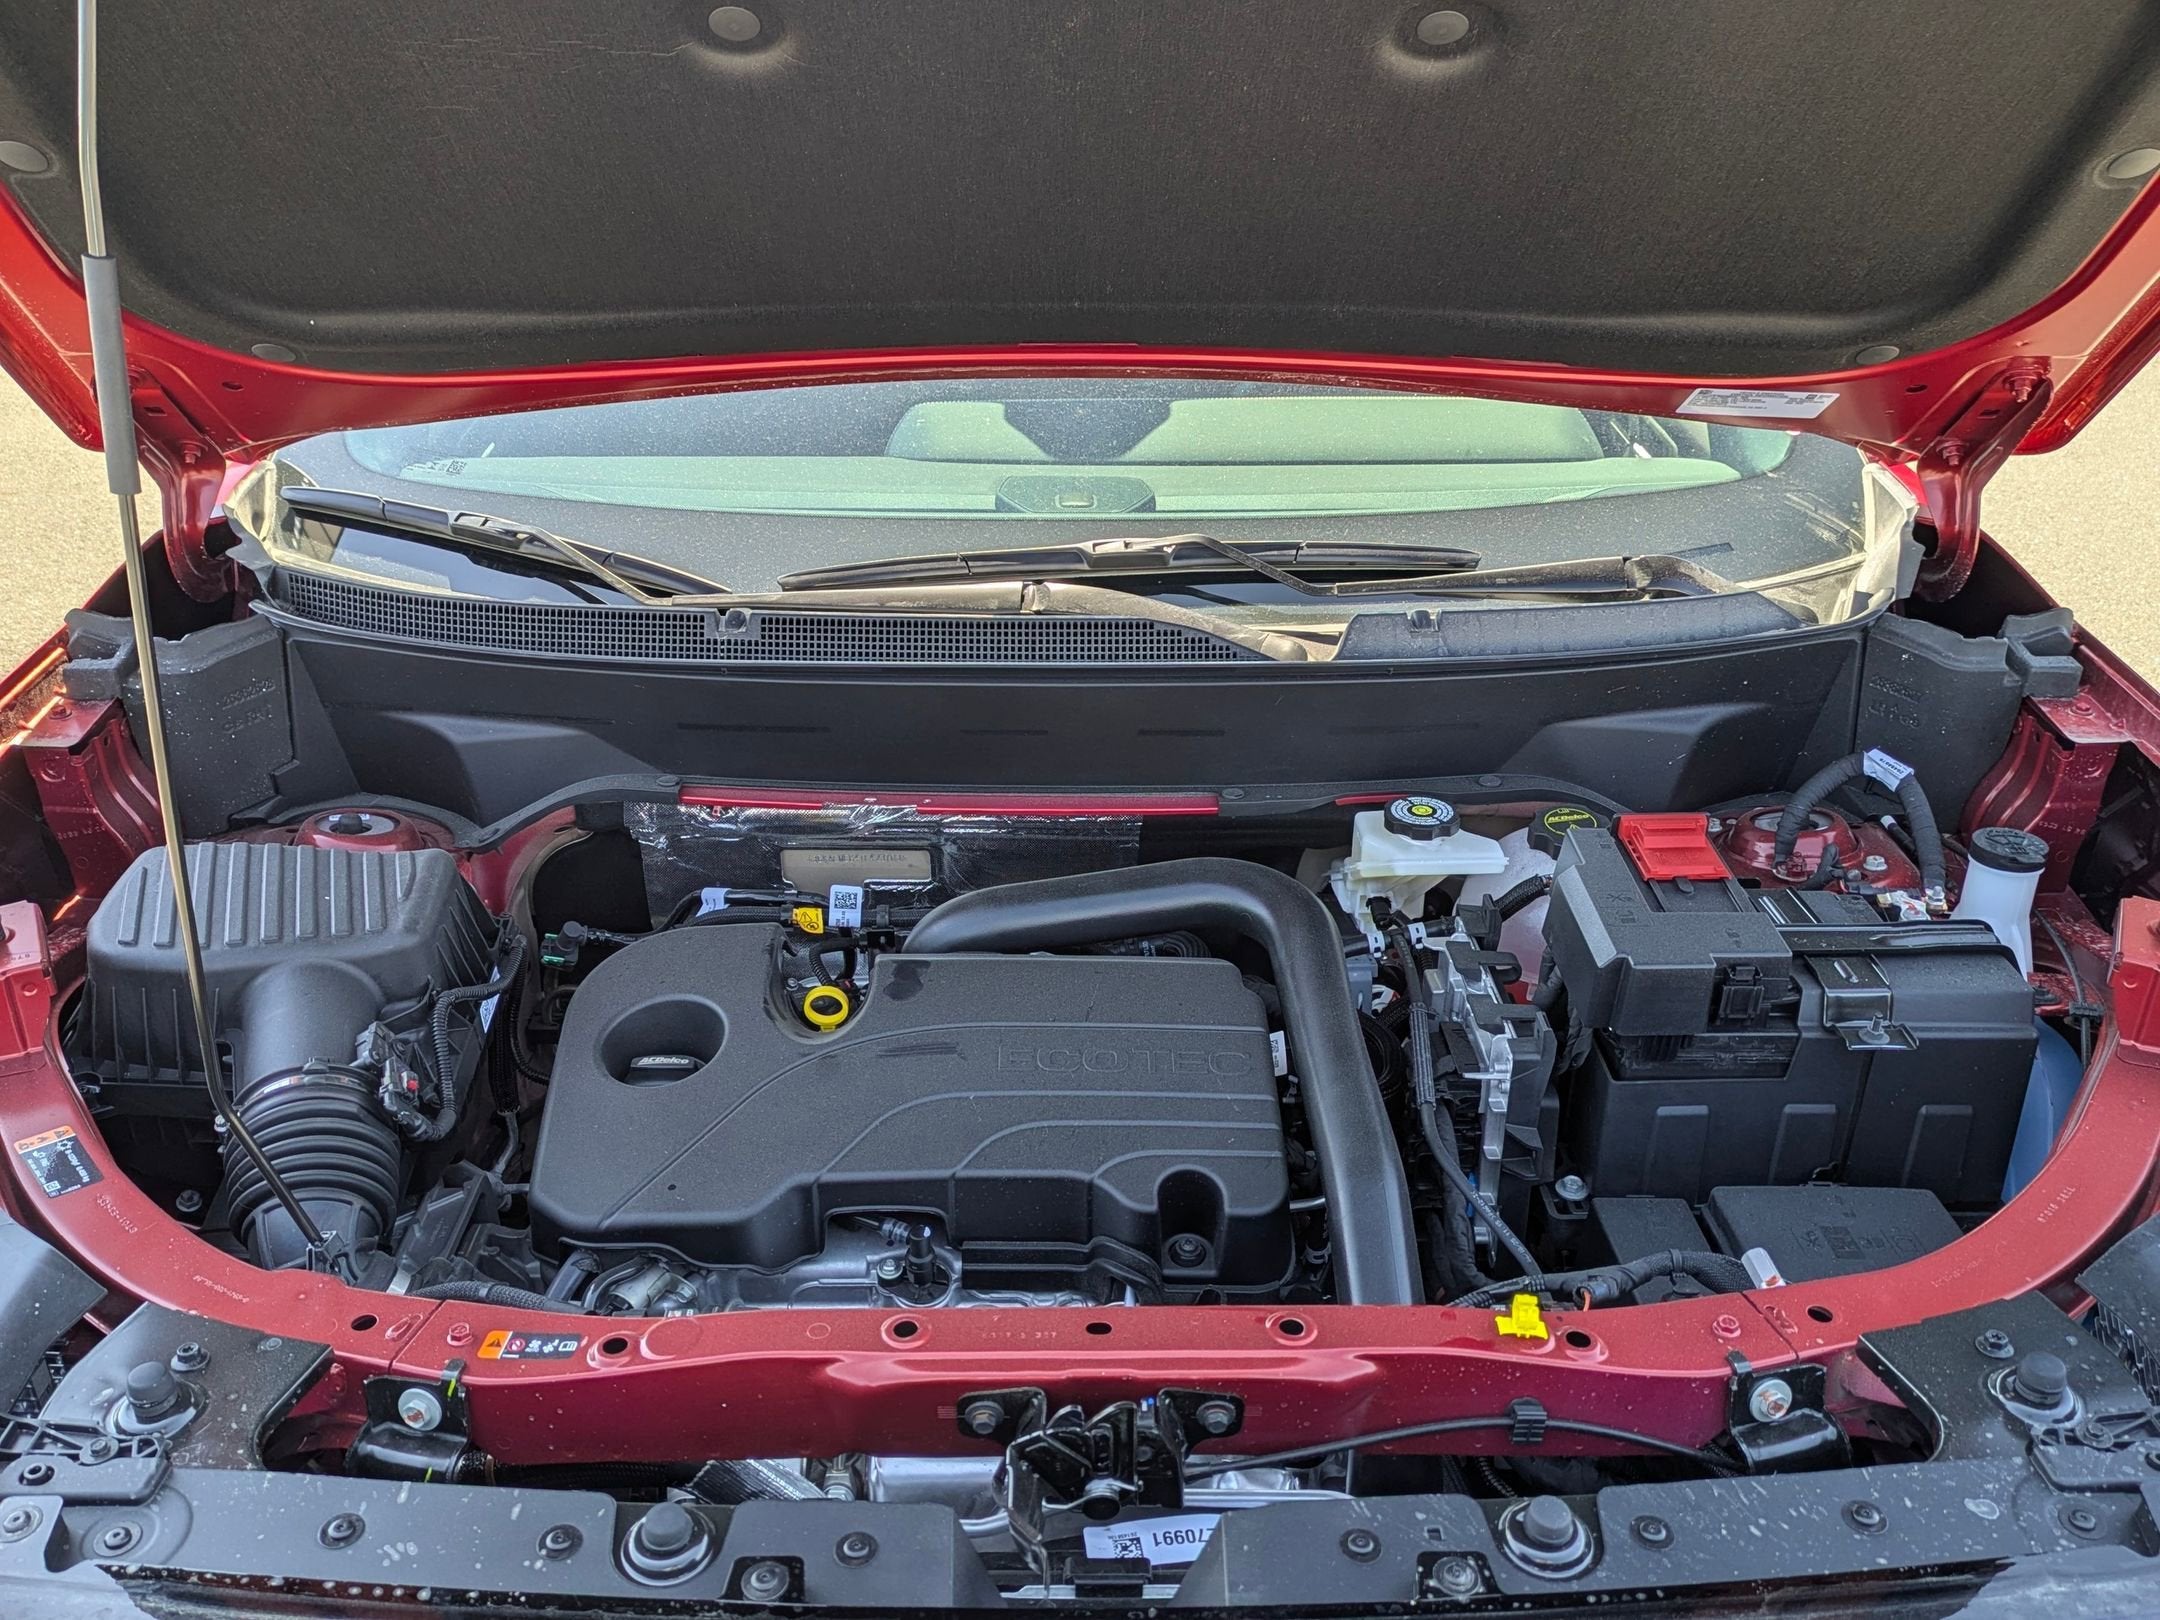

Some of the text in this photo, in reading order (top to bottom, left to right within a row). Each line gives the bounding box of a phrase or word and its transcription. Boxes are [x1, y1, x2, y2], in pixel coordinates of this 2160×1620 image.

[637, 1056, 690, 1067] ACDelco
[998, 1045, 1253, 1076] ECOTEC
[1151, 1527, 1214, 1547] 70991
